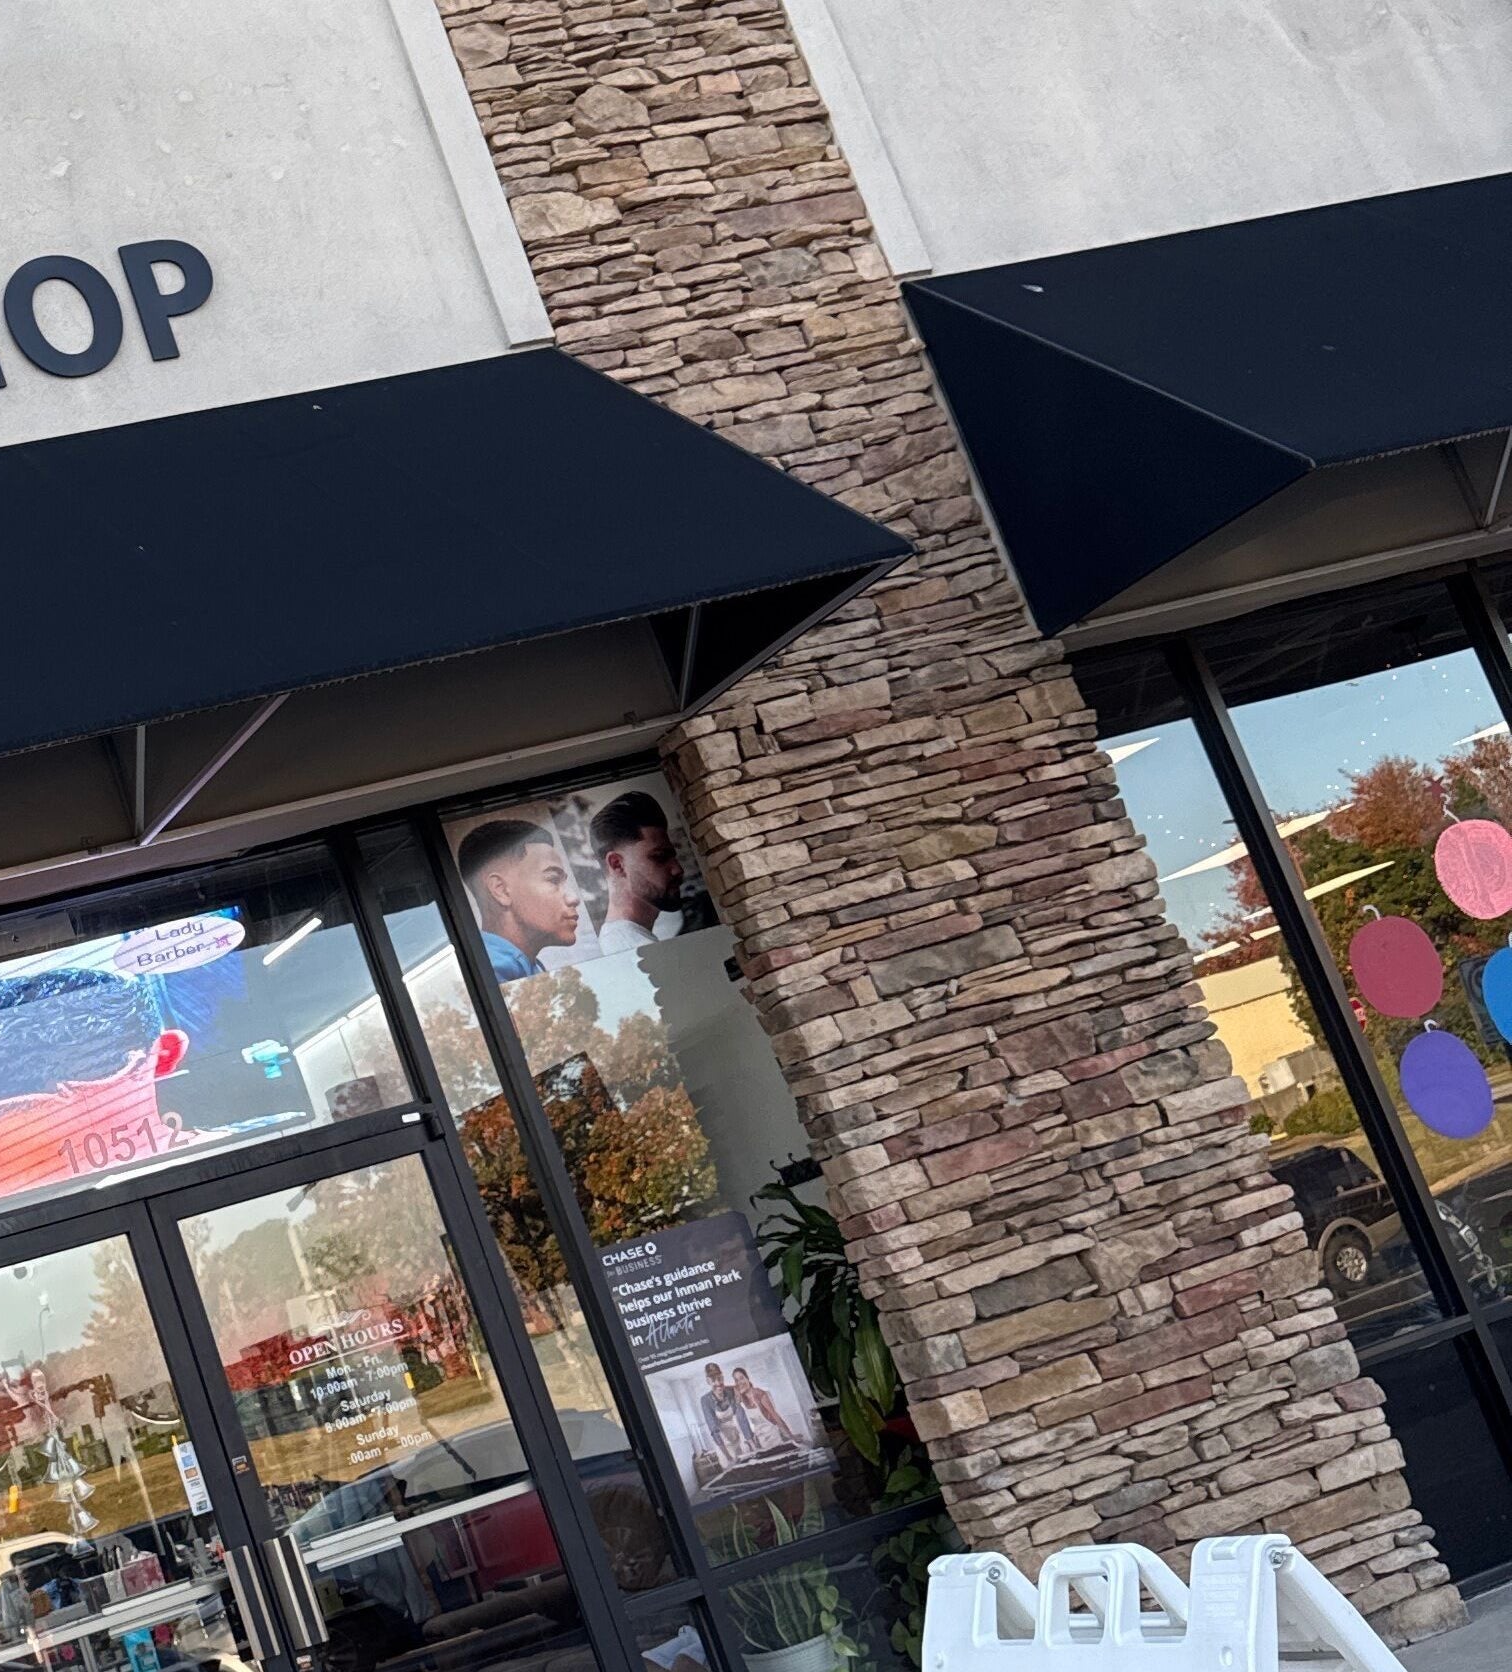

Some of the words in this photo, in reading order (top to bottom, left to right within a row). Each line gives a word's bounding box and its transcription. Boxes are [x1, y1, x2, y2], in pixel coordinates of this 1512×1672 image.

[154, 920, 206, 942] Lady
[57, 1111, 188, 1175] 10512
[602, 1246, 644, 1267] CHASE
[614, 1254, 663, 1277] BUSINESS
[663, 1259, 716, 1286] guidance
[618, 1294, 652, 1315] helps
[652, 1289, 674, 1306] our
[675, 1280, 714, 1299] Inman
[714, 1268, 743, 1288] Park
[624, 1308, 677, 1331] business
[677, 1296, 713, 1316] thrive
[289, 1340, 338, 1366] OPEN
[340, 1317, 405, 1350] HOURS
[362, 1355, 384, 1370] Fri.
[310, 1377, 358, 1400] 10:00am
[366, 1361, 409, 1384] 7:00pm
[340, 1389, 392, 1413] Saturday
[356, 1424, 400, 1446] Sunday
